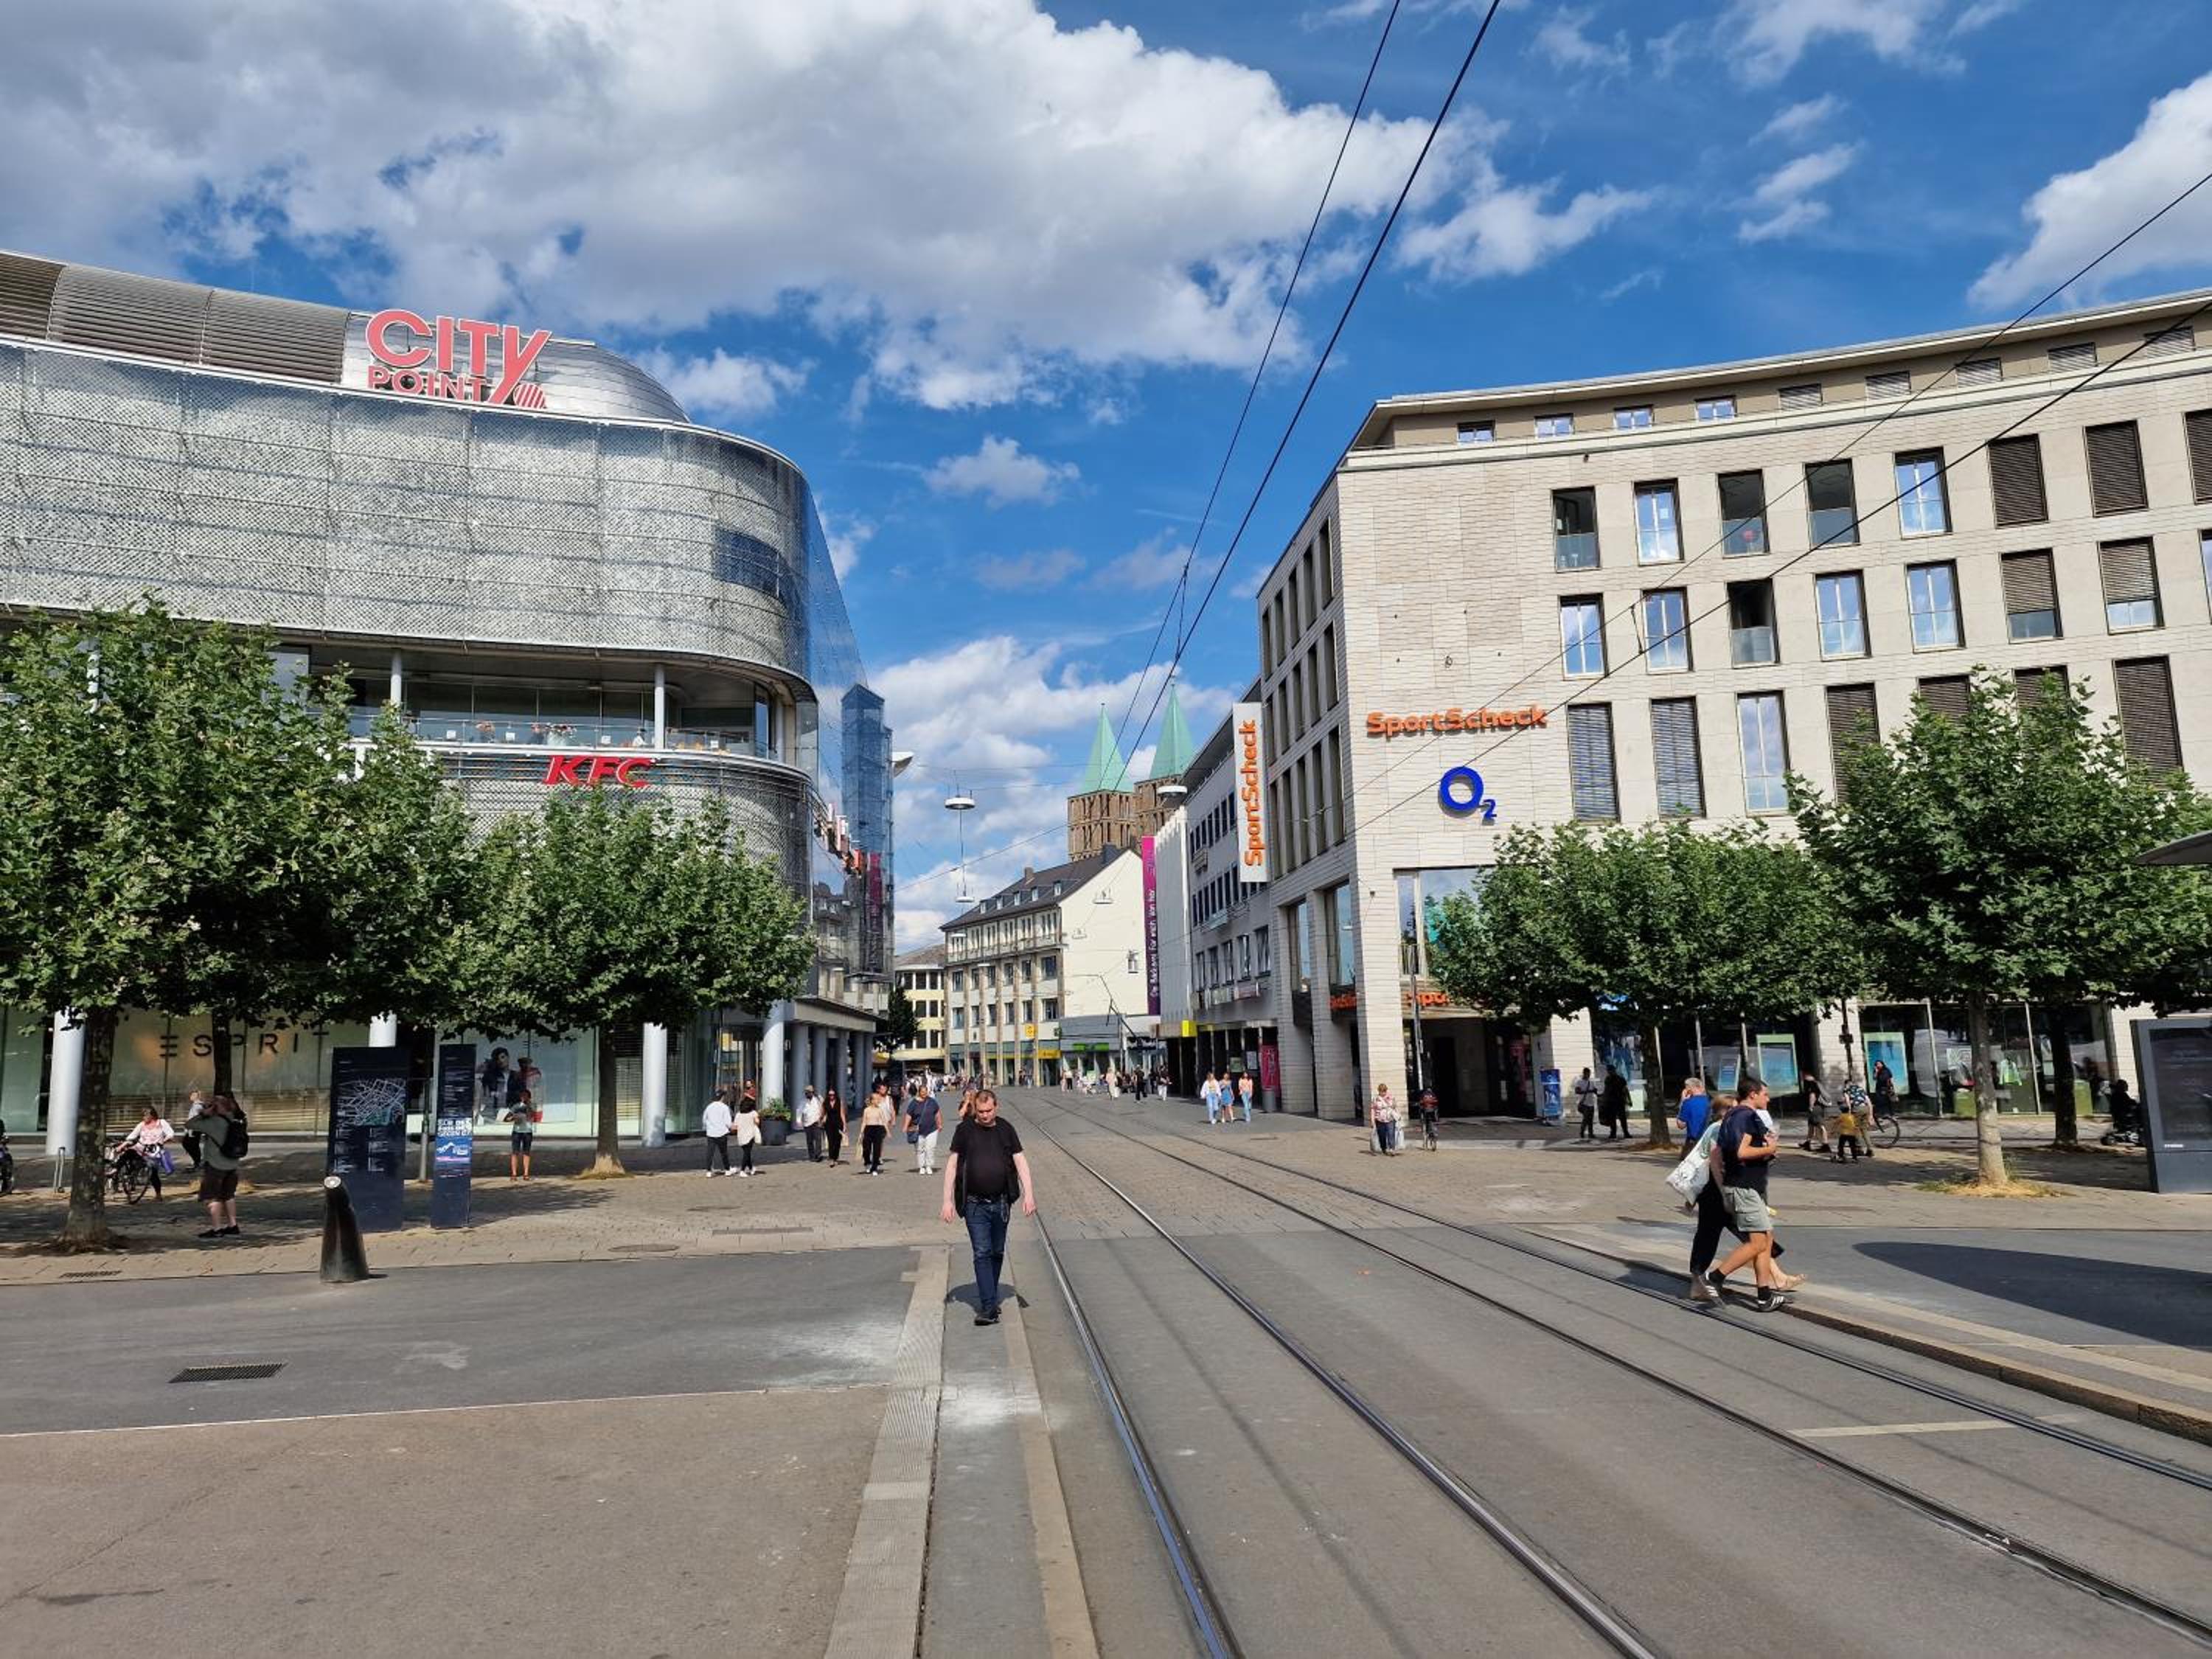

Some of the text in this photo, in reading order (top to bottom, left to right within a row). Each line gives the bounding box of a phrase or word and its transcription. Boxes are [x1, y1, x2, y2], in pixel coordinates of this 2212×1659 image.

[368, 365, 487, 402] POINT
[1366, 704, 1547, 737] SportScheck
[543, 755, 656, 788] KFC
[1239, 720, 1265, 866] SportScheck
[160, 1032, 330, 1057] ESPRIT
